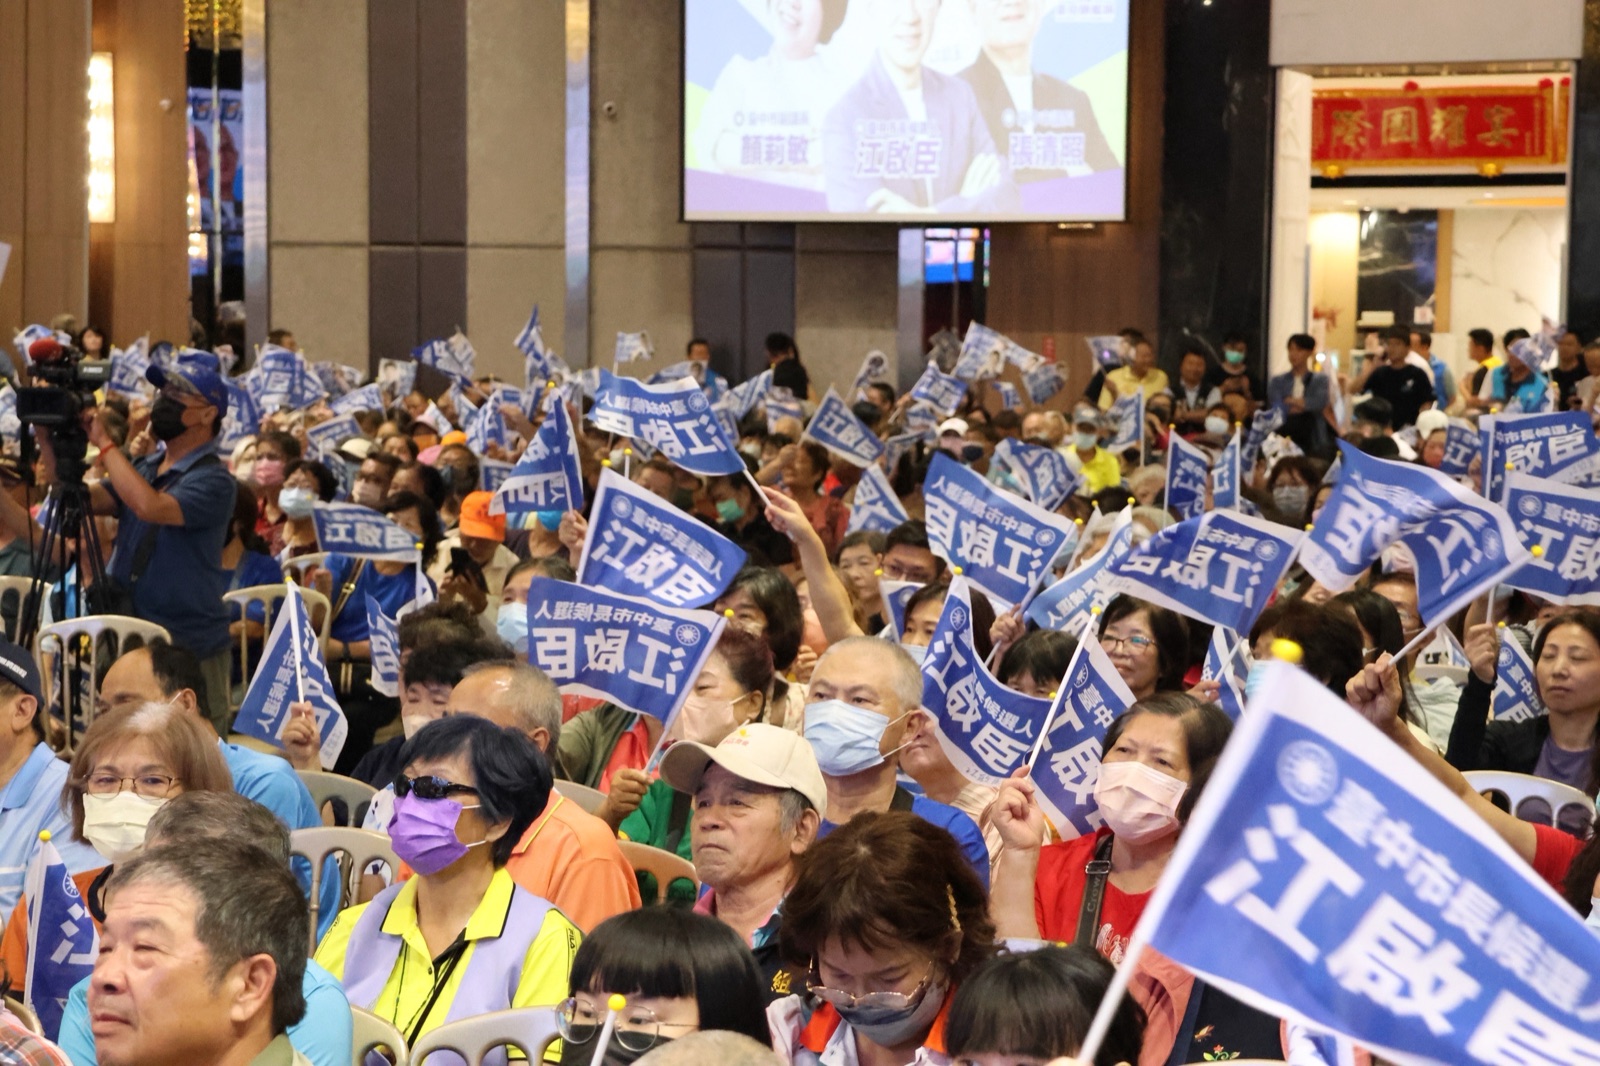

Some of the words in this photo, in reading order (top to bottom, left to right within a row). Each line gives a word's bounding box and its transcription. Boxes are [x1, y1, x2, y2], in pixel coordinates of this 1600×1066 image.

[590, 519, 717, 606] 江啟臣
[1324, 778, 1592, 1018] 臺中市長候選
